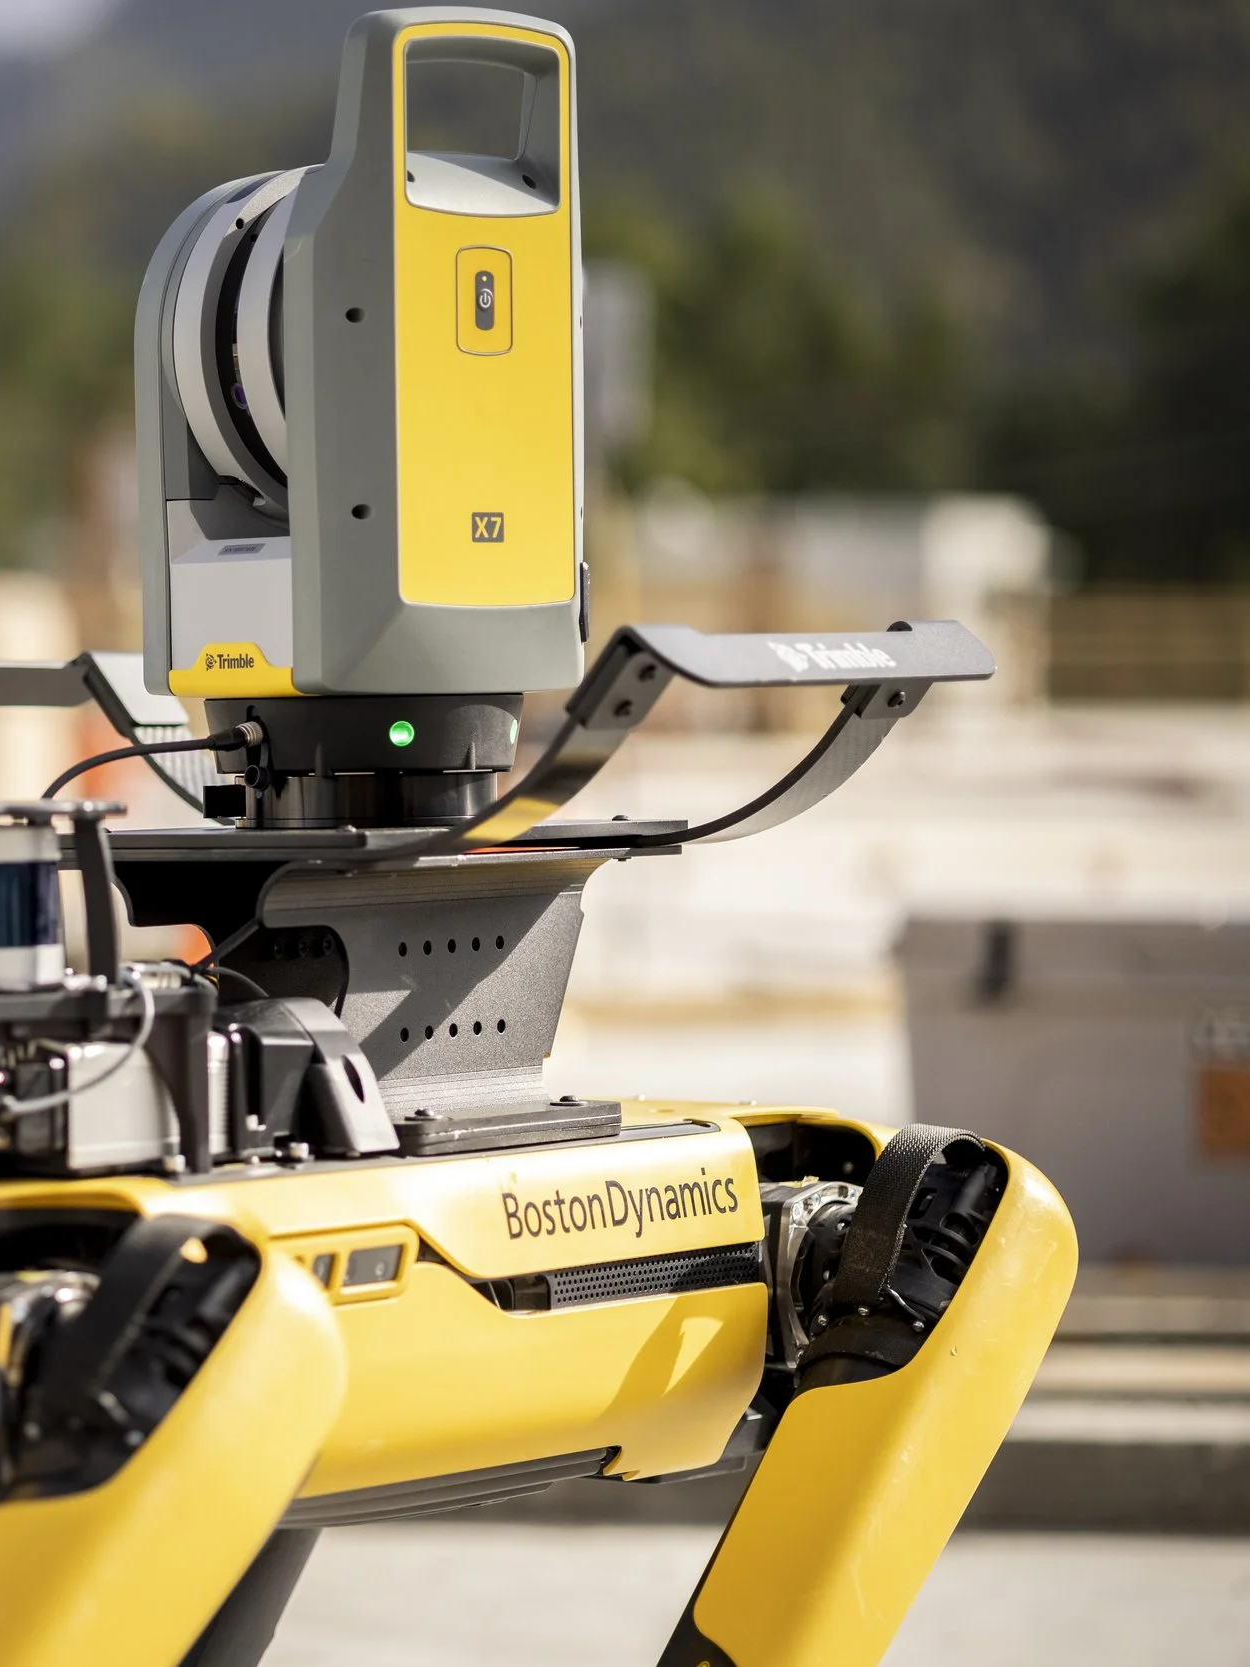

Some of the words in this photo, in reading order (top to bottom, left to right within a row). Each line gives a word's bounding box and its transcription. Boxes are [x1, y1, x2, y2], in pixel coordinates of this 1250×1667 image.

[474, 516, 502, 538] X7
[217, 653, 255, 669] Trimble
[793, 641, 897, 670] Trimble
